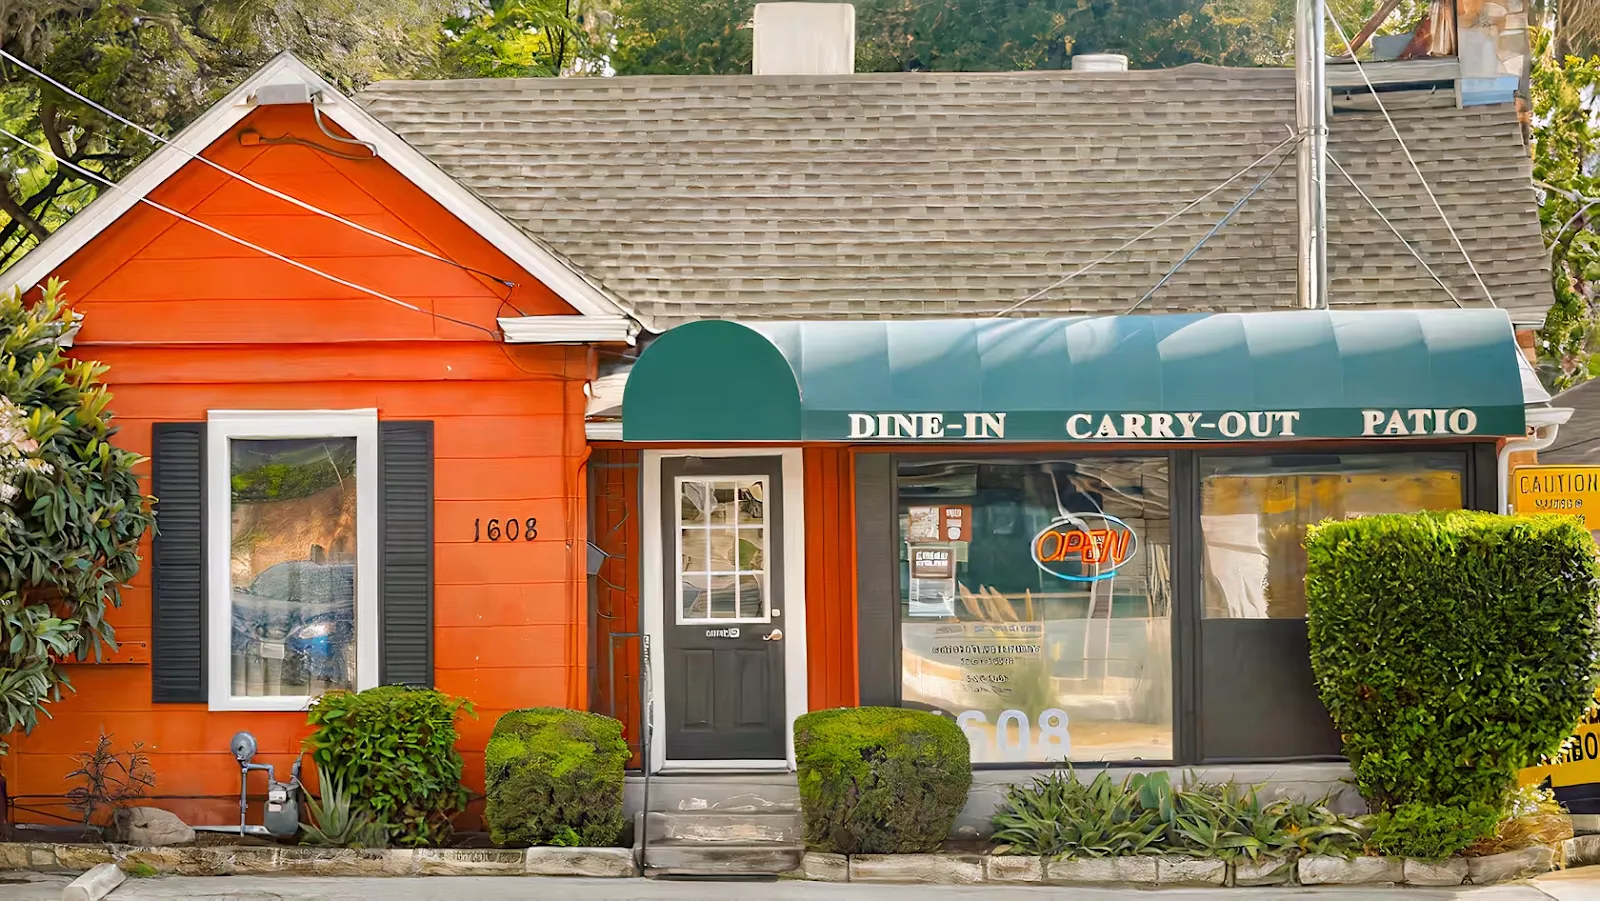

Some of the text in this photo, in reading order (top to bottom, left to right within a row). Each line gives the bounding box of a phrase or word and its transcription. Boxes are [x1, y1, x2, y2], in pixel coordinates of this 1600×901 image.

[847, 408, 1477, 439] DINE-IN CARRY-OUT PATIO
[1520, 473, 1599, 494] CAUTION
[473, 517, 538, 542] 1608
[1036, 528, 1132, 564] OPEN
[932, 708, 1071, 762] 608
